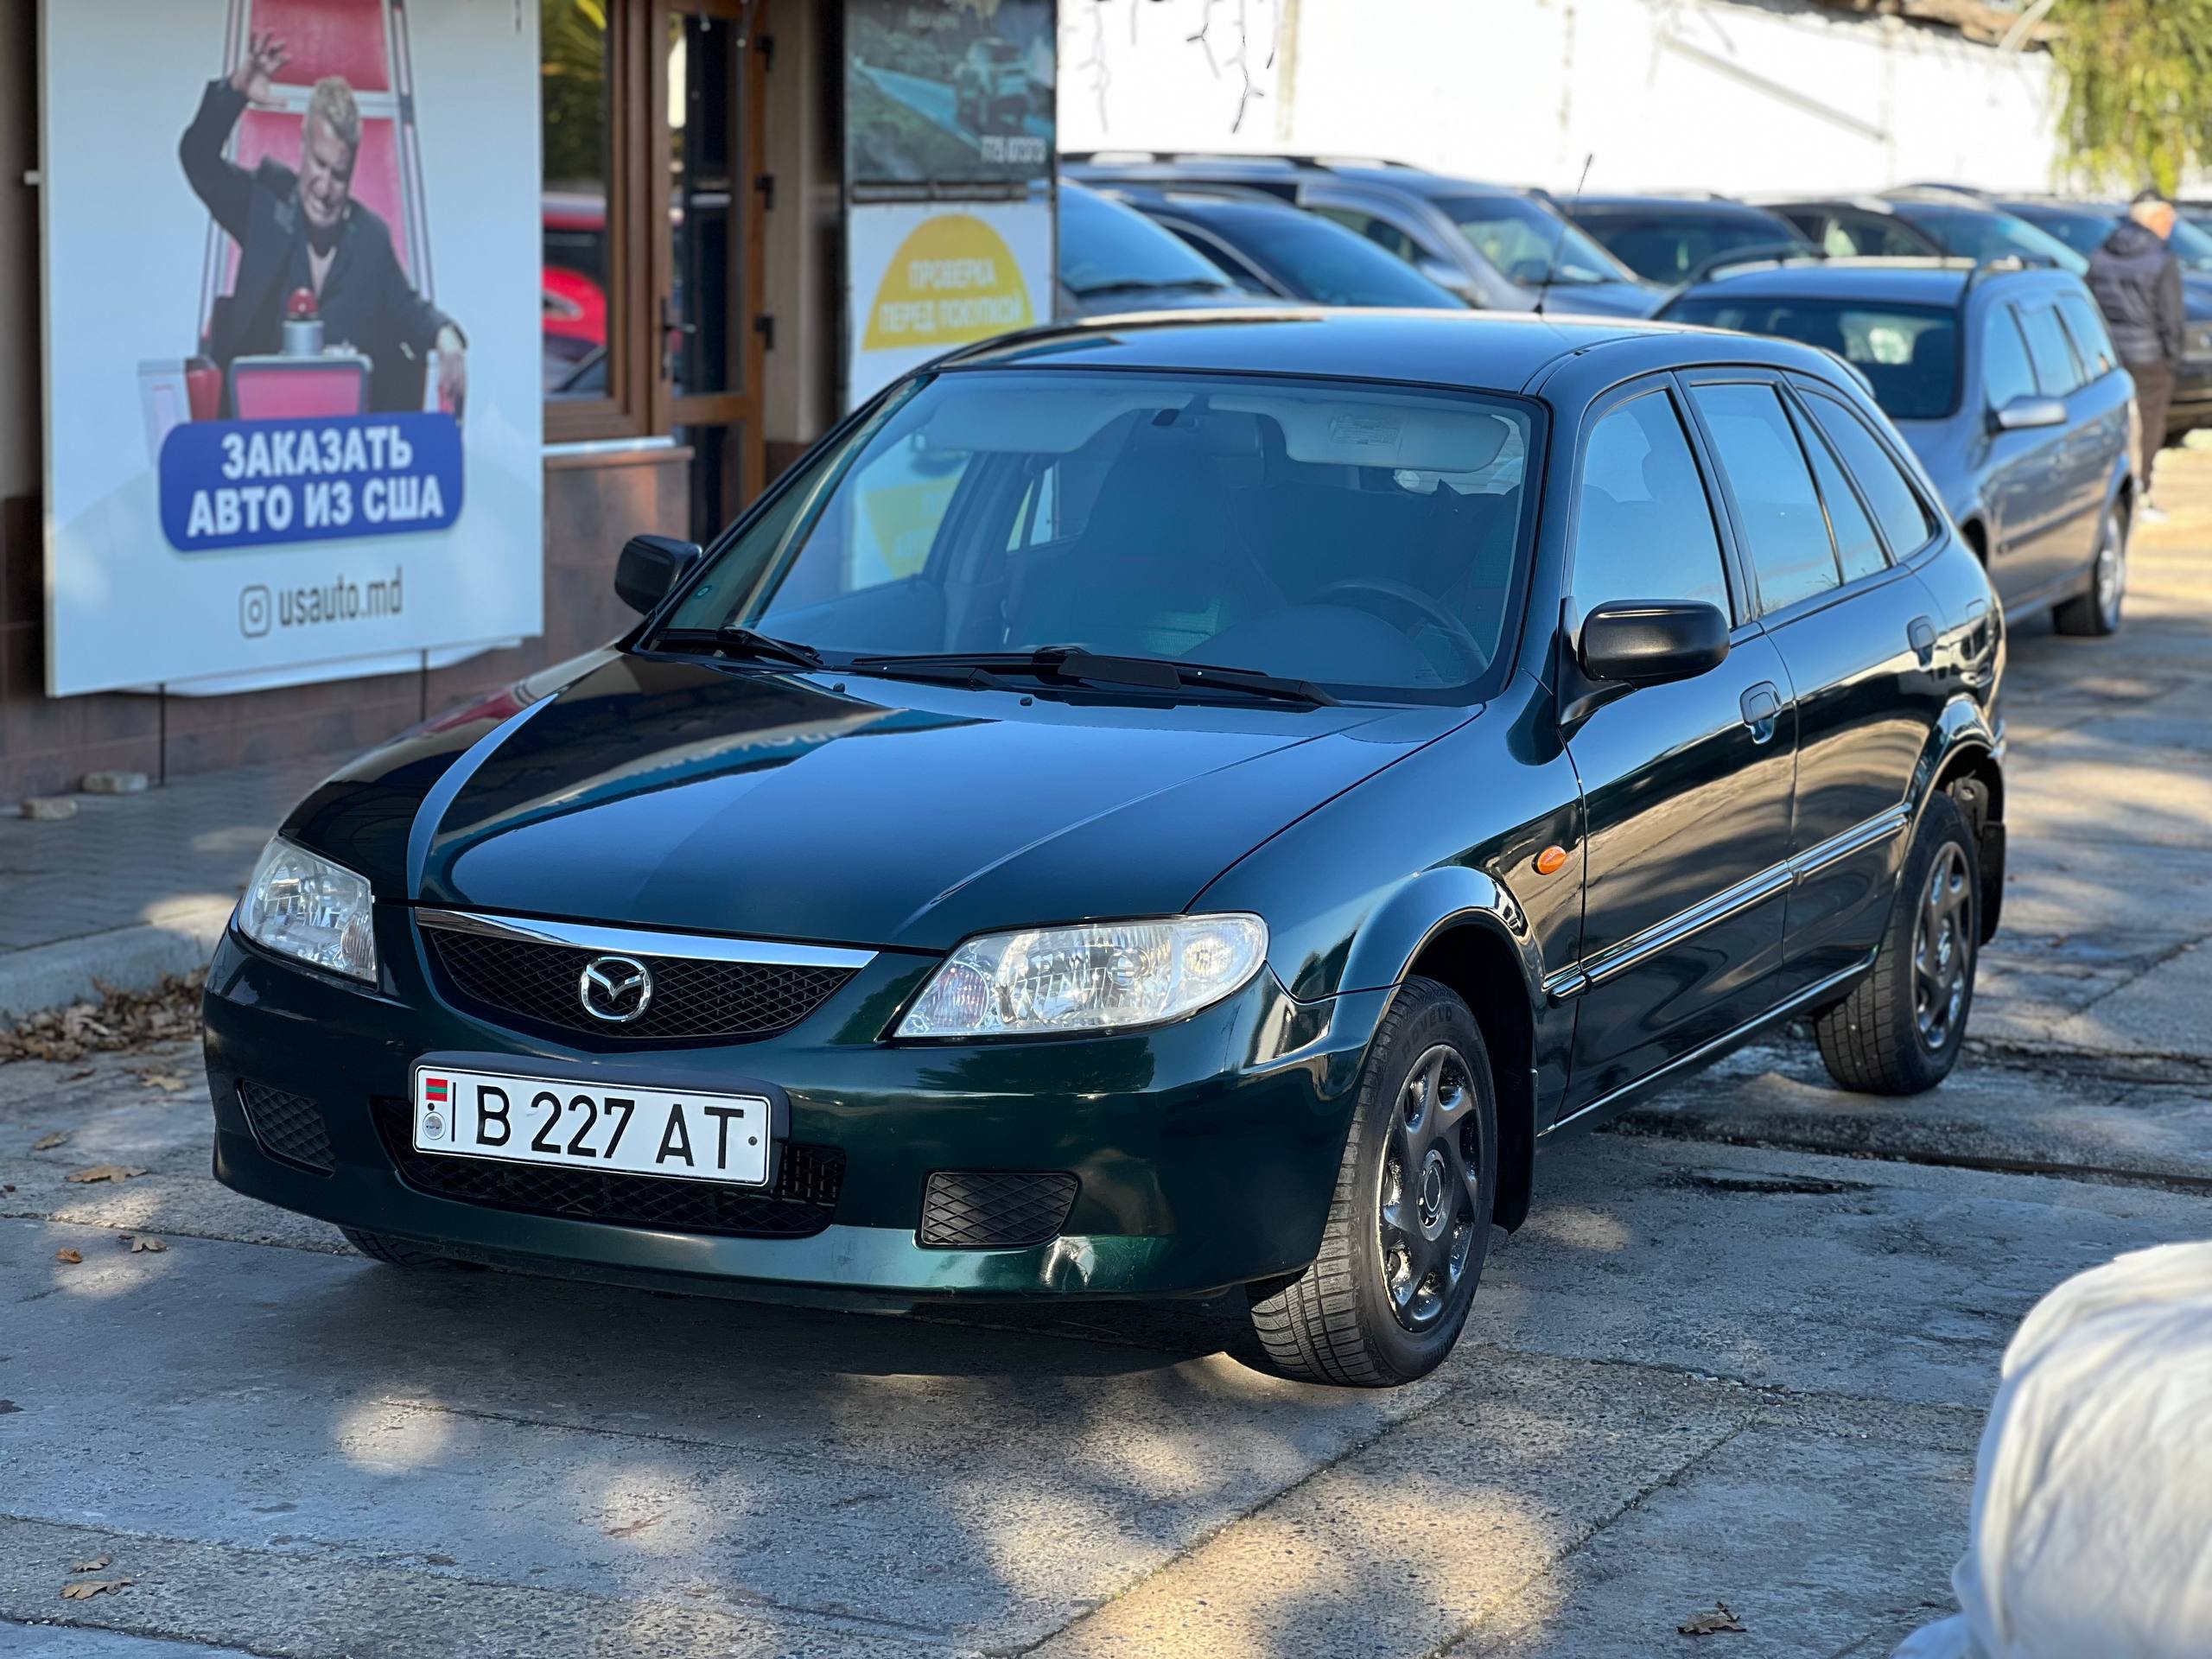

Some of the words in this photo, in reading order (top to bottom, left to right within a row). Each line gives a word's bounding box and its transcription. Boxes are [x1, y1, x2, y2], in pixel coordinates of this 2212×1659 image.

[222, 425, 413, 480] ЗАКАЗАТЬ
[187, 486, 293, 537] АВТО
[303, 480, 353, 529] ИЗ
[363, 474, 444, 522] США
[279, 564, 404, 626] usauto.md
[476, 1084, 511, 1147] B
[531, 1091, 635, 1160] 227
[655, 1103, 745, 1170] AT
